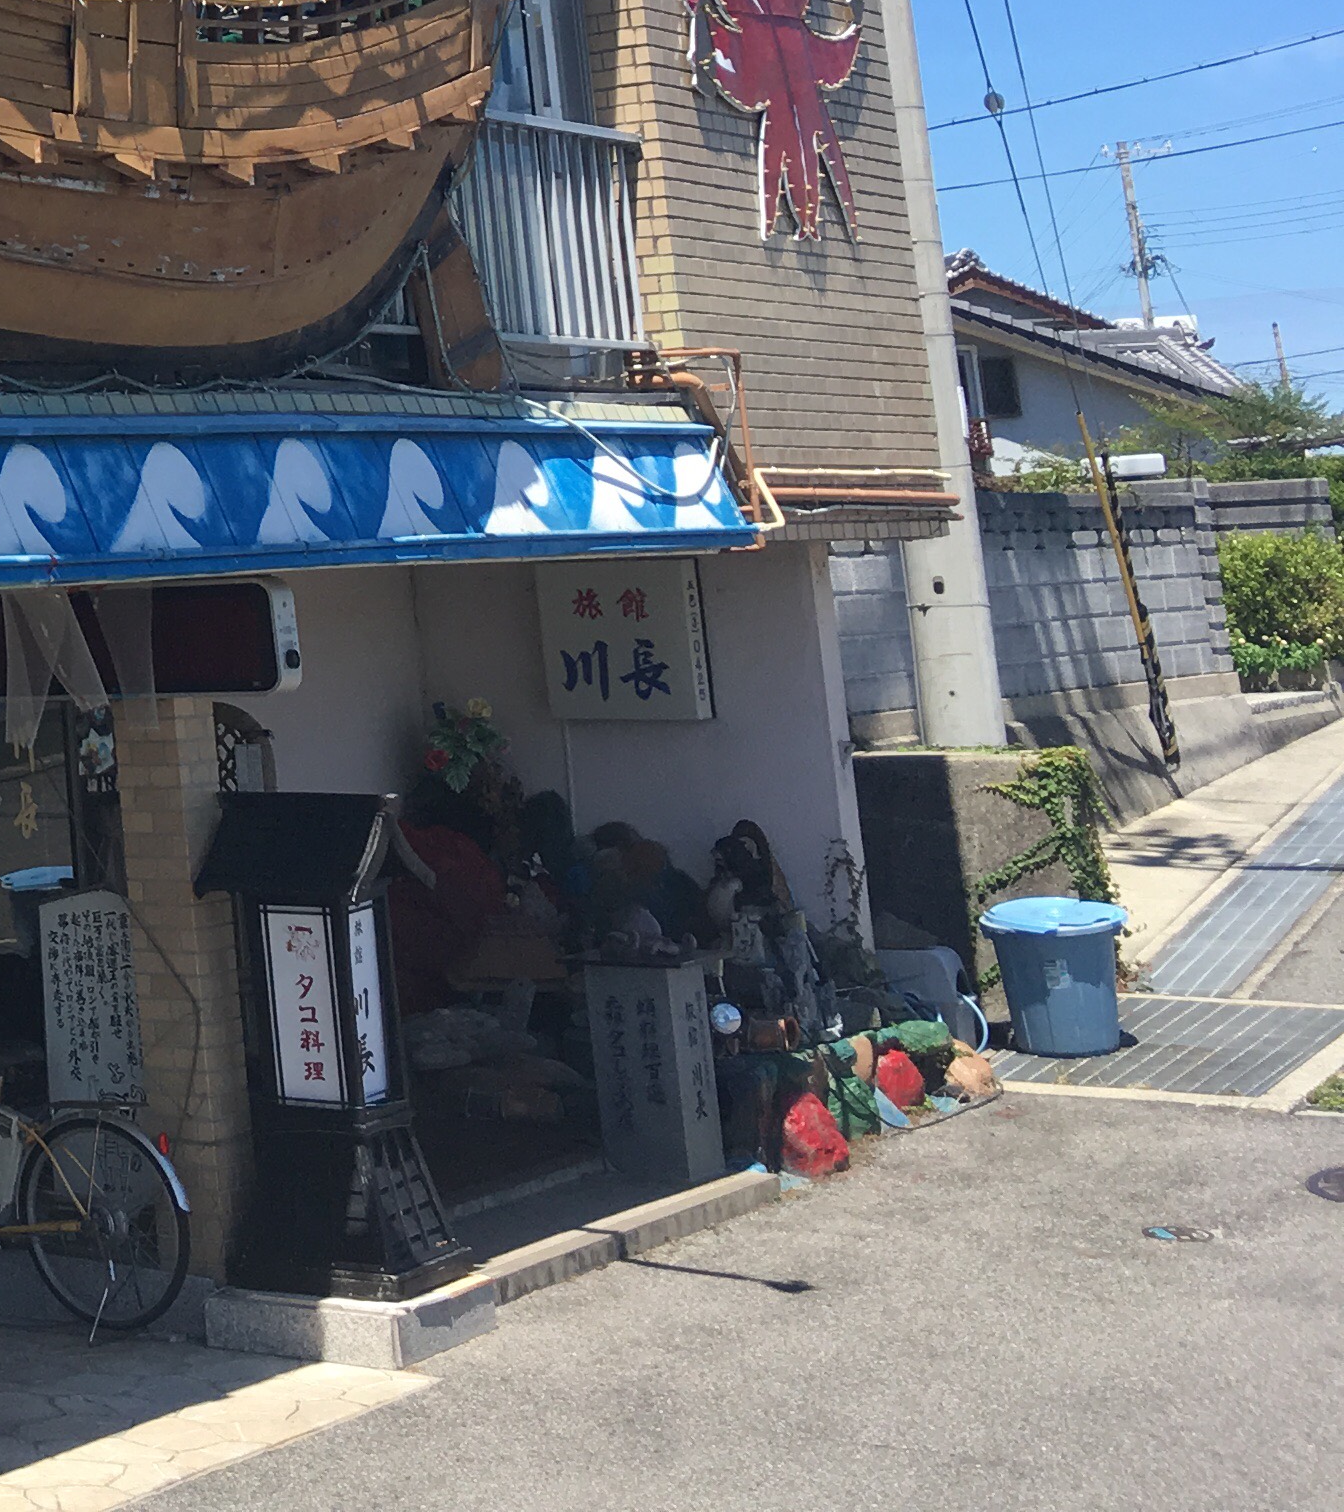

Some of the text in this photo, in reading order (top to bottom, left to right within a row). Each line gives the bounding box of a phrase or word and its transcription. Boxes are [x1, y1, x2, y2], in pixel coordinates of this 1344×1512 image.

[572, 587, 650, 622] 旅館
[560, 638, 672, 702] 川長
[294, 973, 326, 1082] タコ料理
